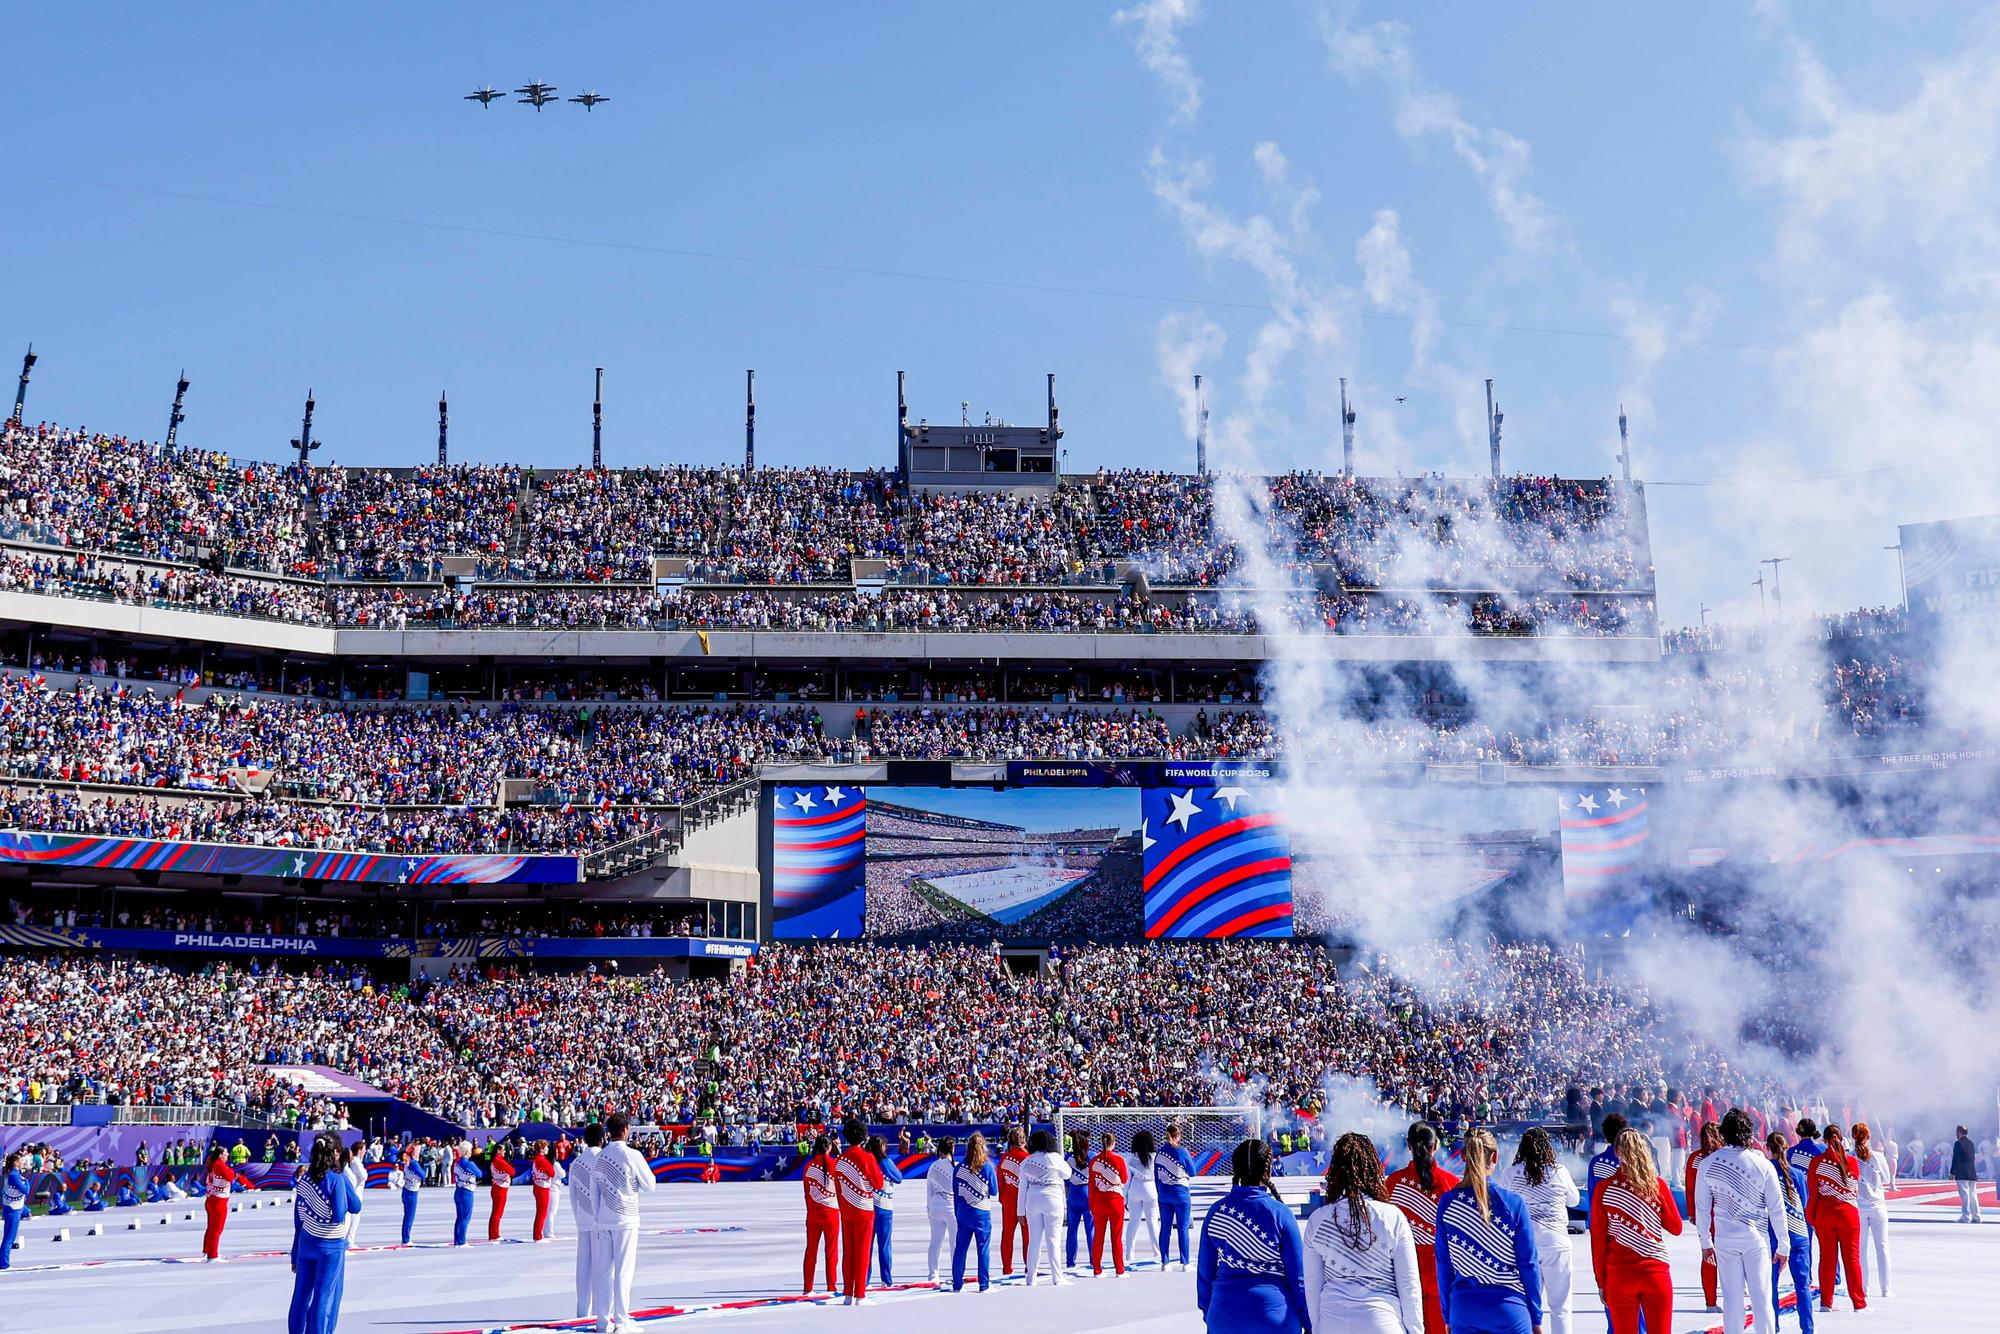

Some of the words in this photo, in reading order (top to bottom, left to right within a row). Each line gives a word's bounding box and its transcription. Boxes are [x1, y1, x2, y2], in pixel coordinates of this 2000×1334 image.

[168, 426, 176, 445] 216
[1881, 756, 1897, 765] THE
[1899, 754, 1920, 763] FREE
[1921, 753, 1940, 761] AND
[1941, 751, 1958, 760] THE
[1959, 750, 1984, 759] HOME
[1931, 760, 1948, 769] THE
[1023, 768, 1088, 777] PHILADELPHIA
[1165, 769, 1185, 777] FIFA
[1186, 769, 1218, 777] WORLD
[1219, 769, 1238, 777] CUP
[1238, 769, 1270, 777] 2026
[175, 934, 317, 951] PHILADELPHIA
